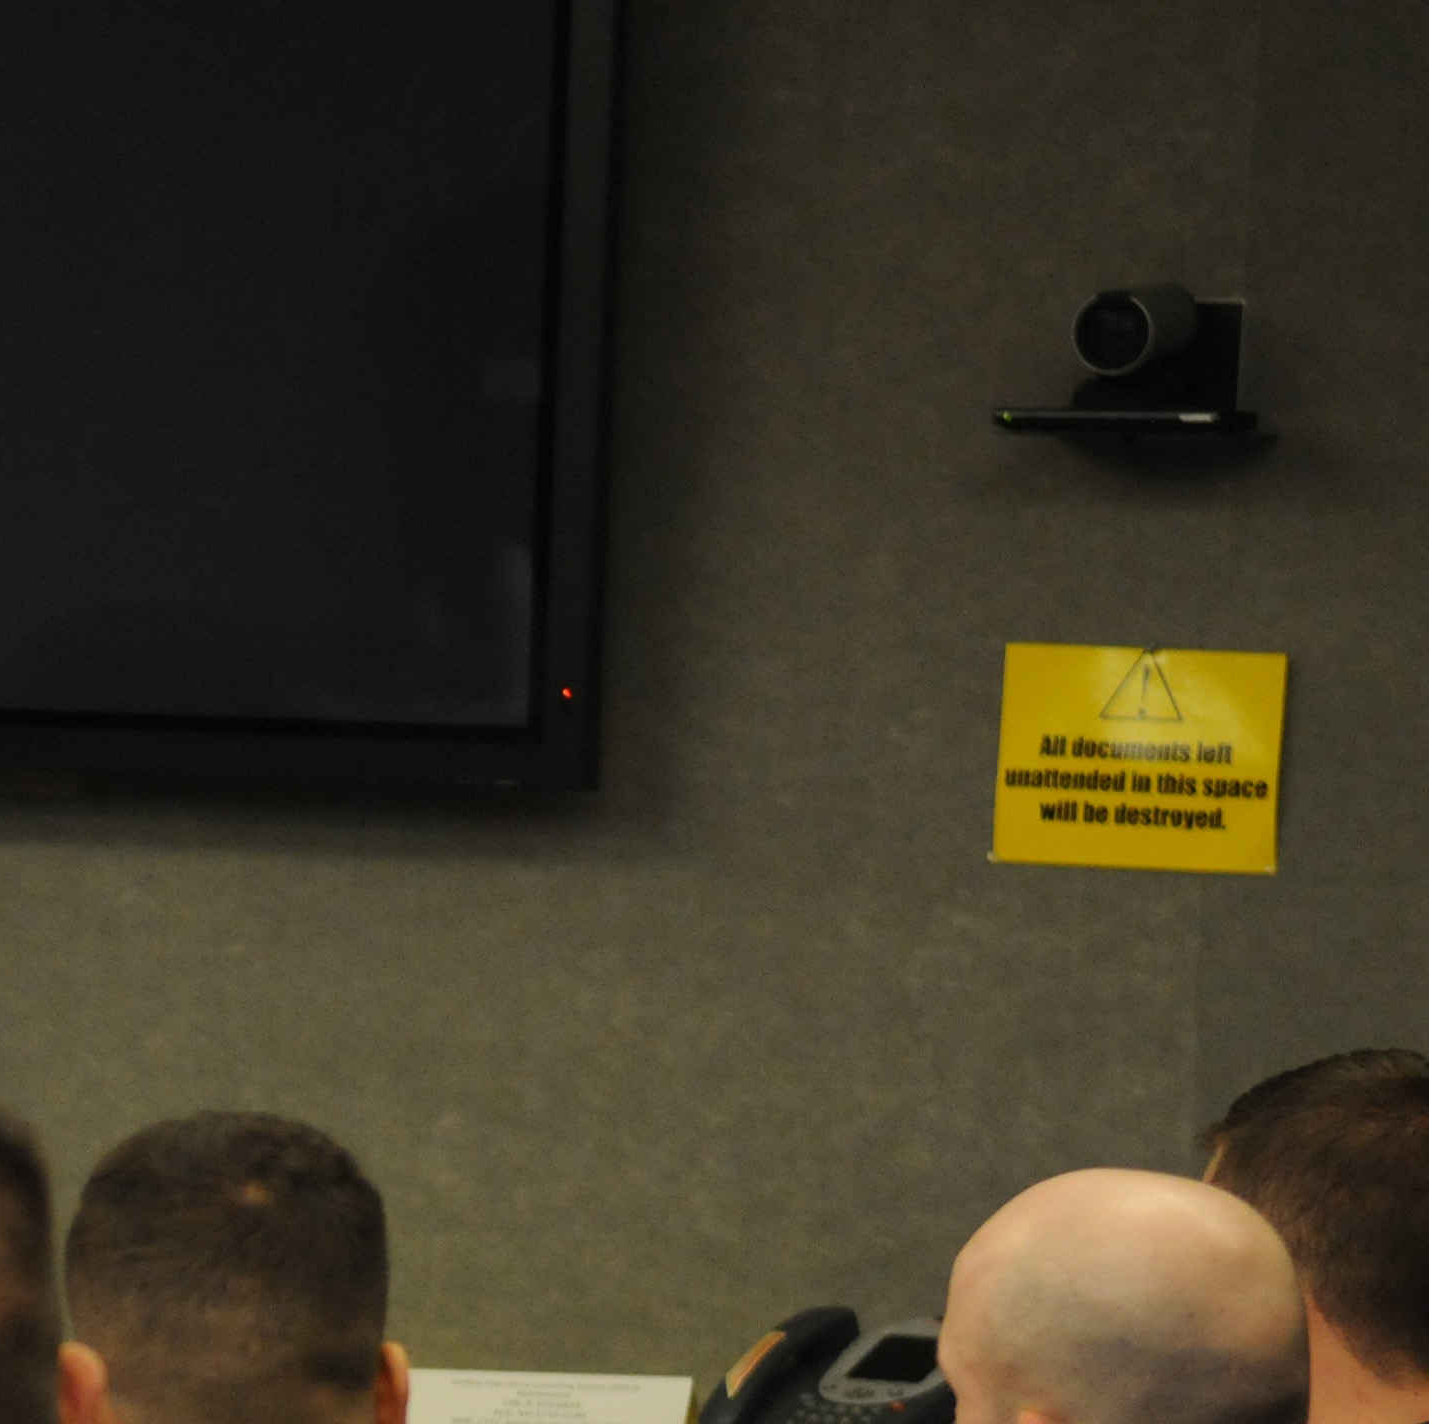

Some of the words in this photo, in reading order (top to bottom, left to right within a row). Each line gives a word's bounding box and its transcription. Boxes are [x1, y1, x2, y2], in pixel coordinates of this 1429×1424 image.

[1040, 735, 1067, 756] All
[1072, 737, 1191, 763] documents
[1197, 740, 1232, 765] left
[1005, 768, 1125, 792] unattended
[1131, 771, 1151, 793] in
[1157, 773, 1197, 796] this
[1202, 777, 1268, 799] space
[1040, 800, 1078, 821] will
[1084, 801, 1109, 824] be
[1114, 803, 1226, 830] destroyed.
